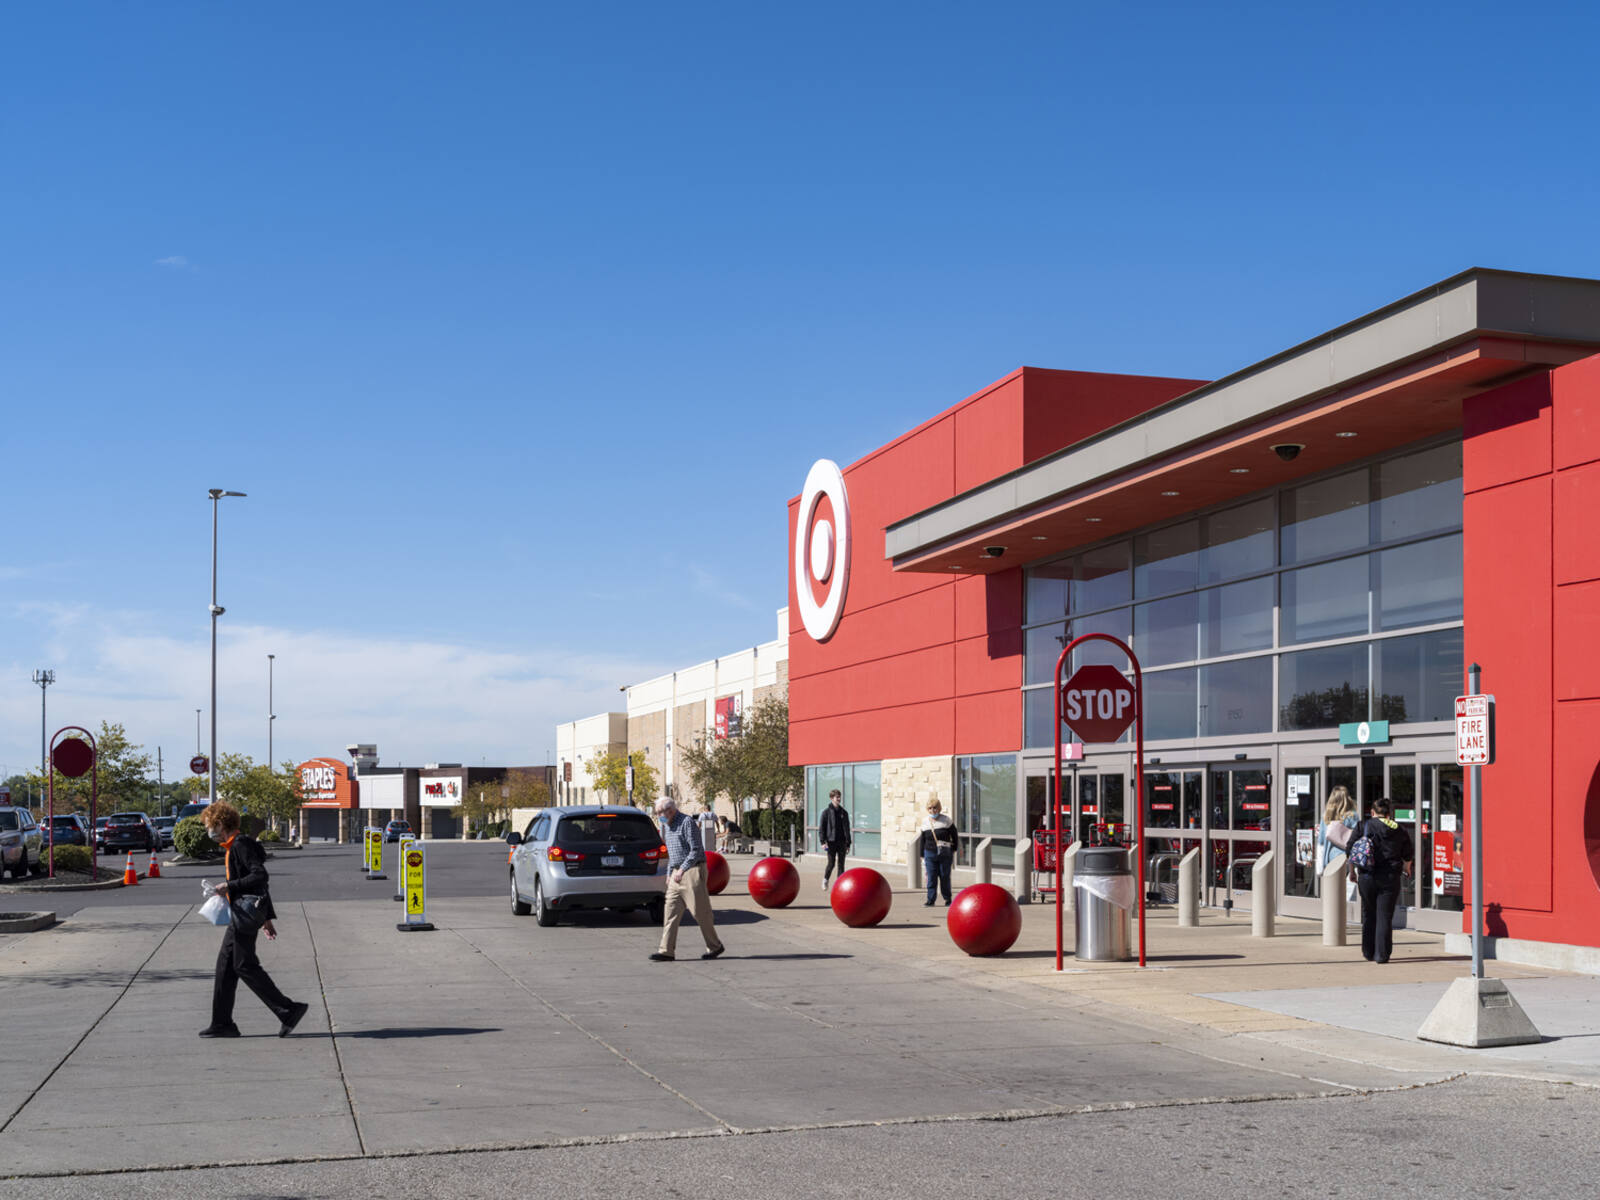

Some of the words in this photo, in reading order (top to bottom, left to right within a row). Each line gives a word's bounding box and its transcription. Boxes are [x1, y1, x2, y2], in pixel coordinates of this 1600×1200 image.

[1067, 689, 1131, 720] STOP
[1456, 700, 1466, 714] NO
[1461, 720, 1482, 733] FIRE
[1460, 736, 1484, 749] LANE
[302, 767, 336, 790] STAPLES
